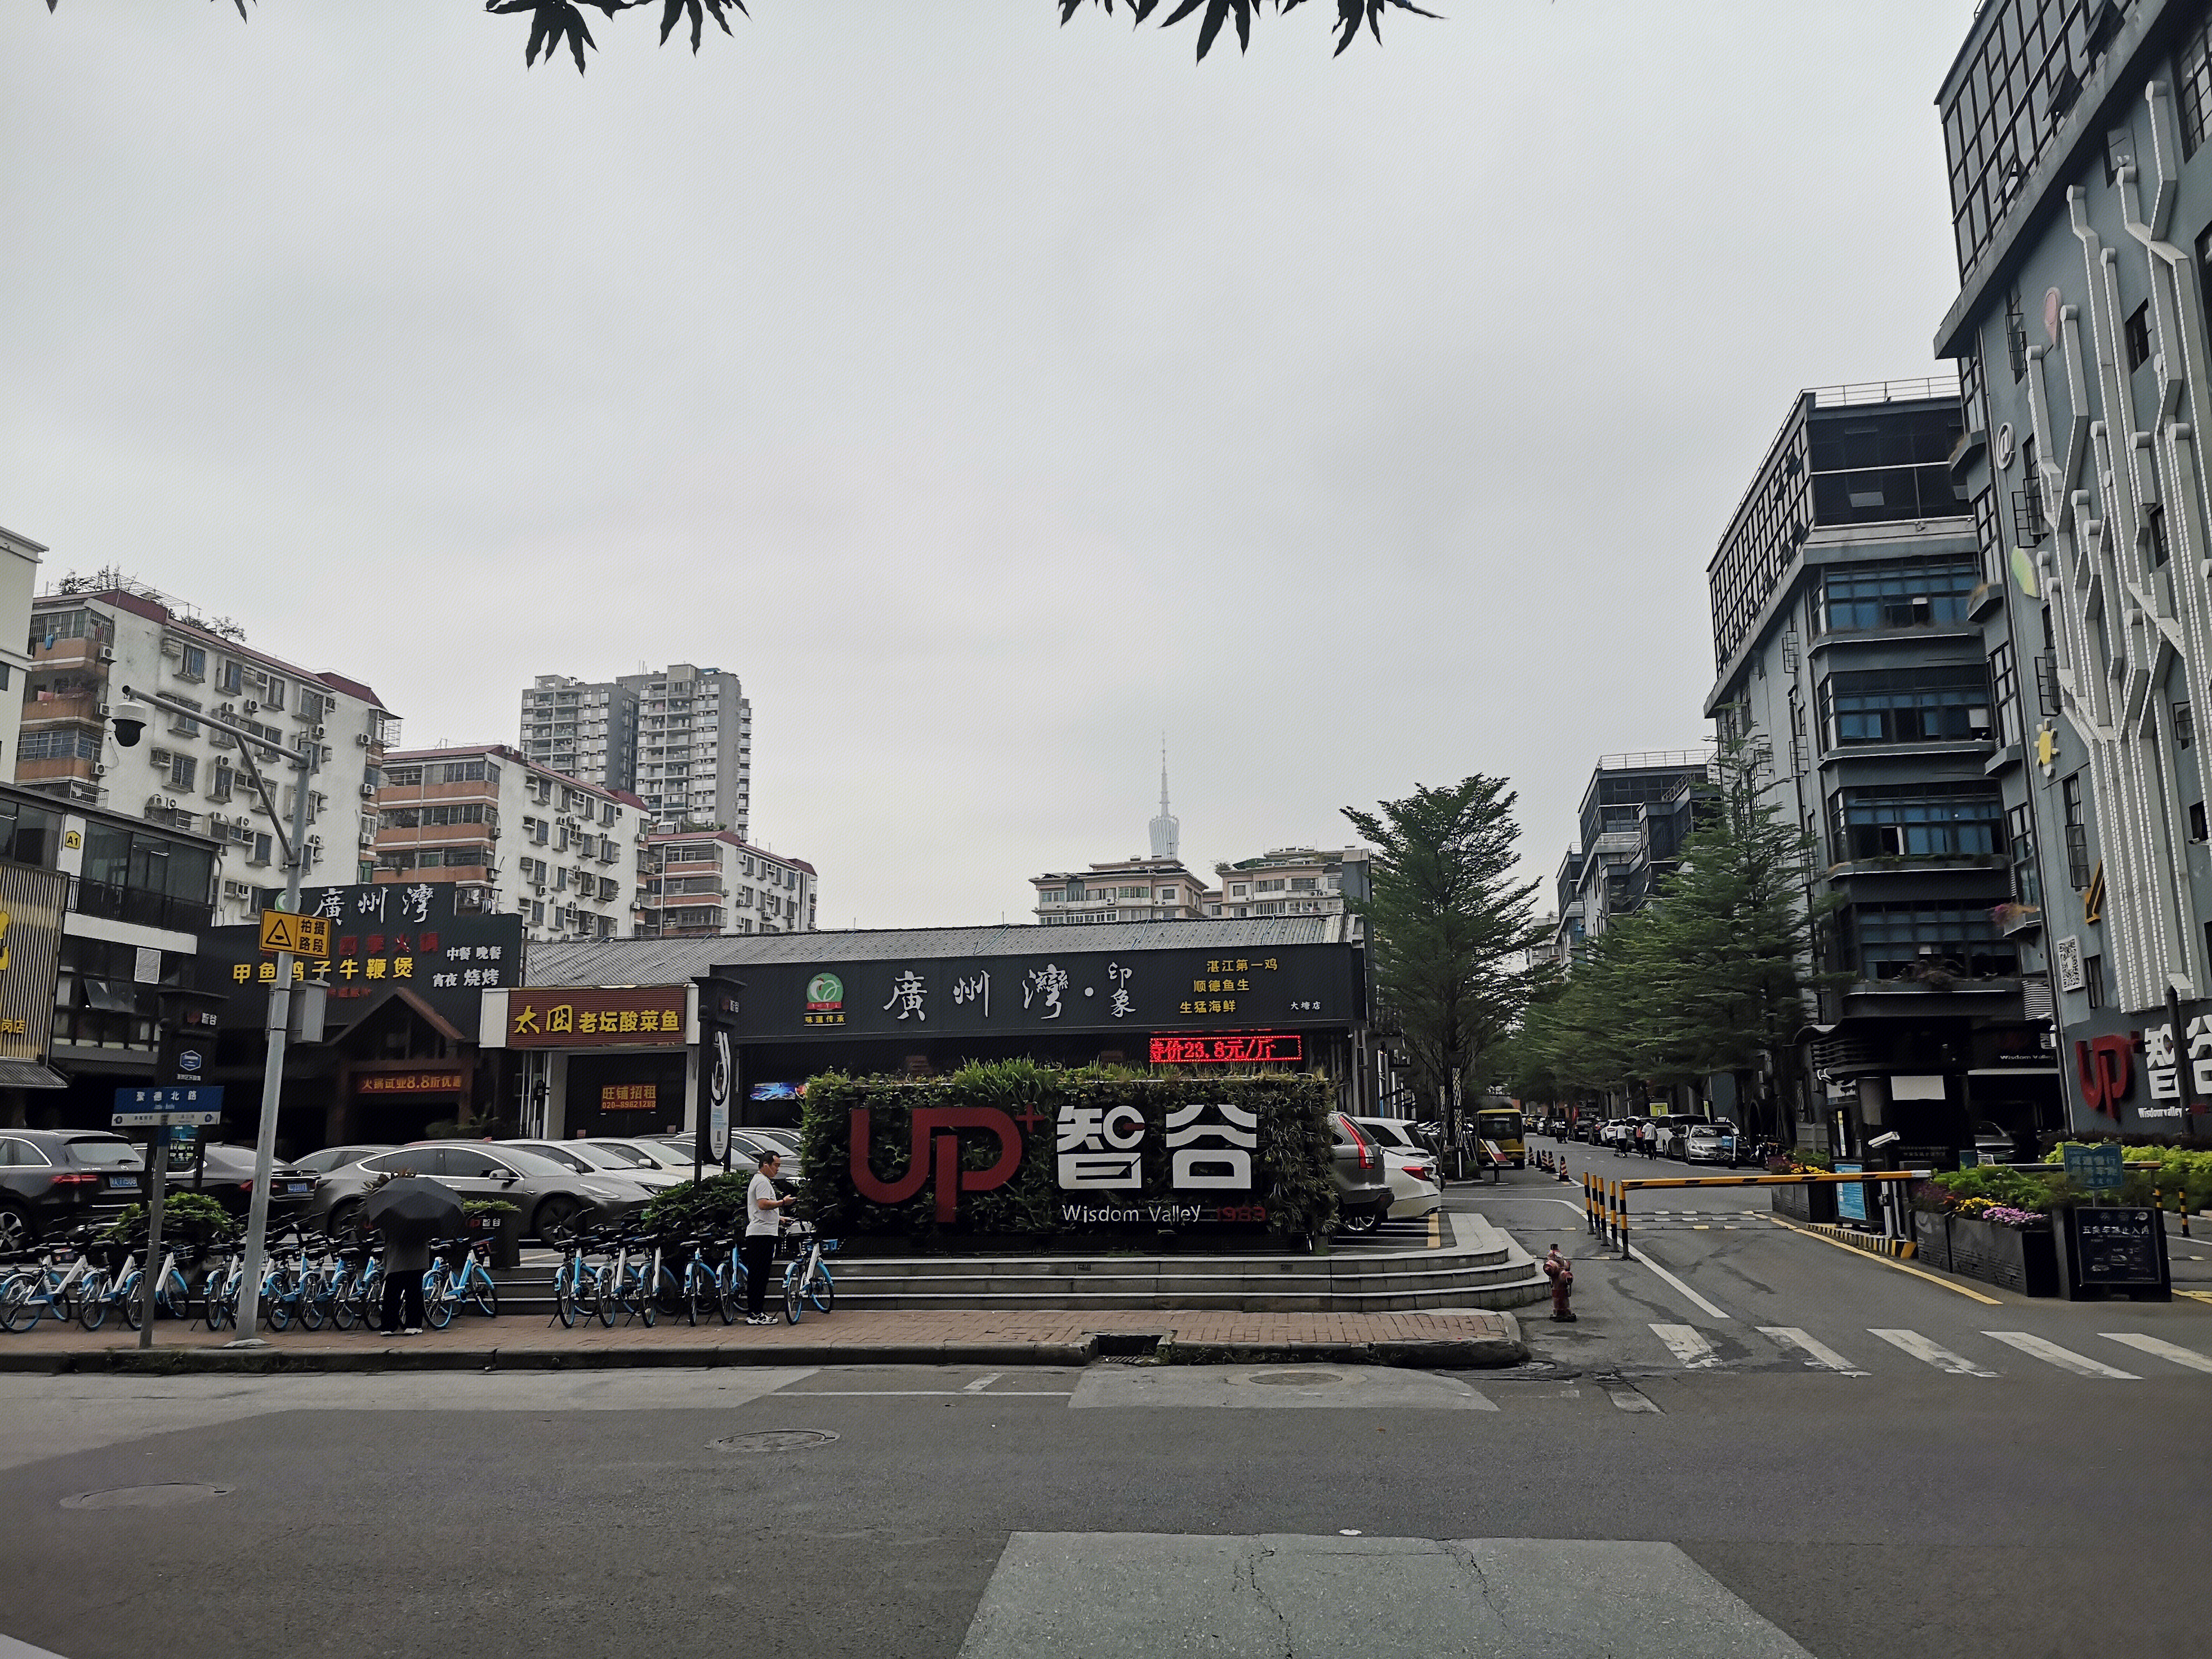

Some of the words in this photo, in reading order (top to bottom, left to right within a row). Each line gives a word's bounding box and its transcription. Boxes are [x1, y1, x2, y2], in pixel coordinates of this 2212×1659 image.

[67, 834, 79, 847] A1
[312, 884, 434, 925] 廣州灣
[300, 919, 326, 936] 拍摄
[299, 936, 324, 953] 路段
[447, 947, 470, 961] 中餐
[476, 945, 502, 961] 晚餐
[1206, 958, 1278, 973] 湛江第一鸡
[433, 973, 457, 988] 宵夜
[463, 968, 499, 987] 烧烤
[1193, 978, 1250, 993] 顺德鱼生
[1179, 1000, 1237, 1015] 生猛海鲜
[1290, 1001, 1321, 1011] 大塘店
[0, 1017, 26, 1034] 岗店
[602, 1085, 656, 1100] 旺铺招租
[1057, 1104, 1257, 1190] 智谷
[1063, 1204, 1139, 1223] Wisdom
[1149, 1204, 1201, 1223] Valley
